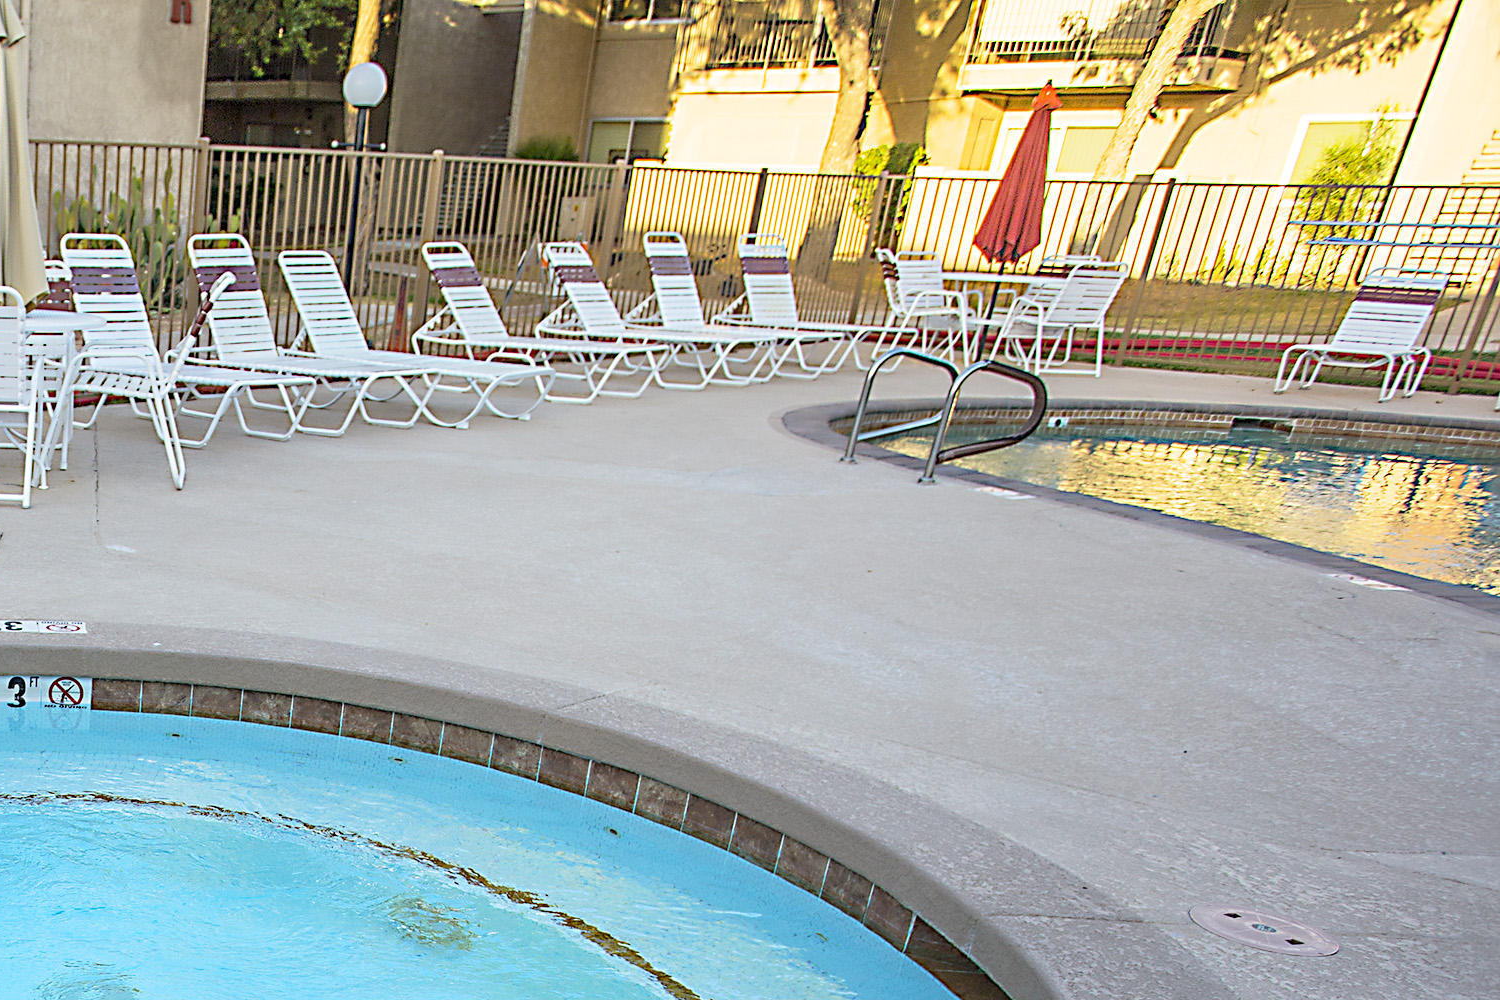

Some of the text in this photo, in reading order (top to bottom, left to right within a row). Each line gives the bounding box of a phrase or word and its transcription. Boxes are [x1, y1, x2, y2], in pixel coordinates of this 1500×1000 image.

[4, 621, 23, 631] 3
[7, 676, 40, 708] 3 FT
